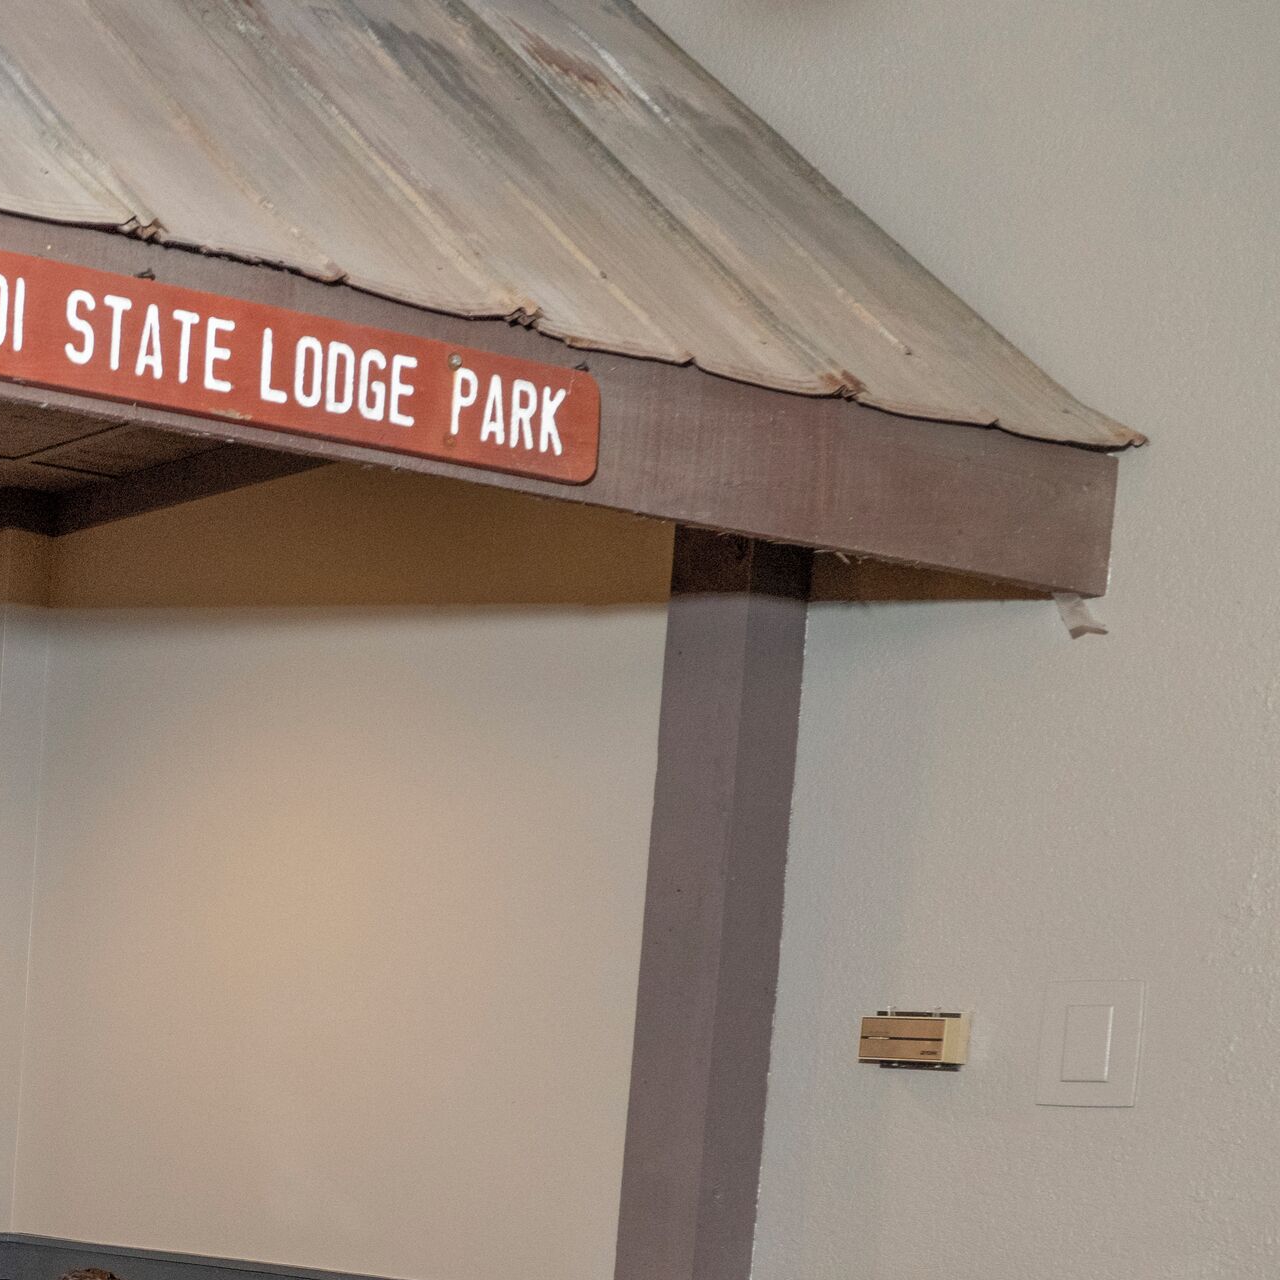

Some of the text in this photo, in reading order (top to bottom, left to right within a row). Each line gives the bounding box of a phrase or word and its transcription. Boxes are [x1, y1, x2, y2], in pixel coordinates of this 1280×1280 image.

[64, 289, 236, 393] STATE
[259, 326, 418, 428] LODGE
[449, 366, 567, 456] PARK
